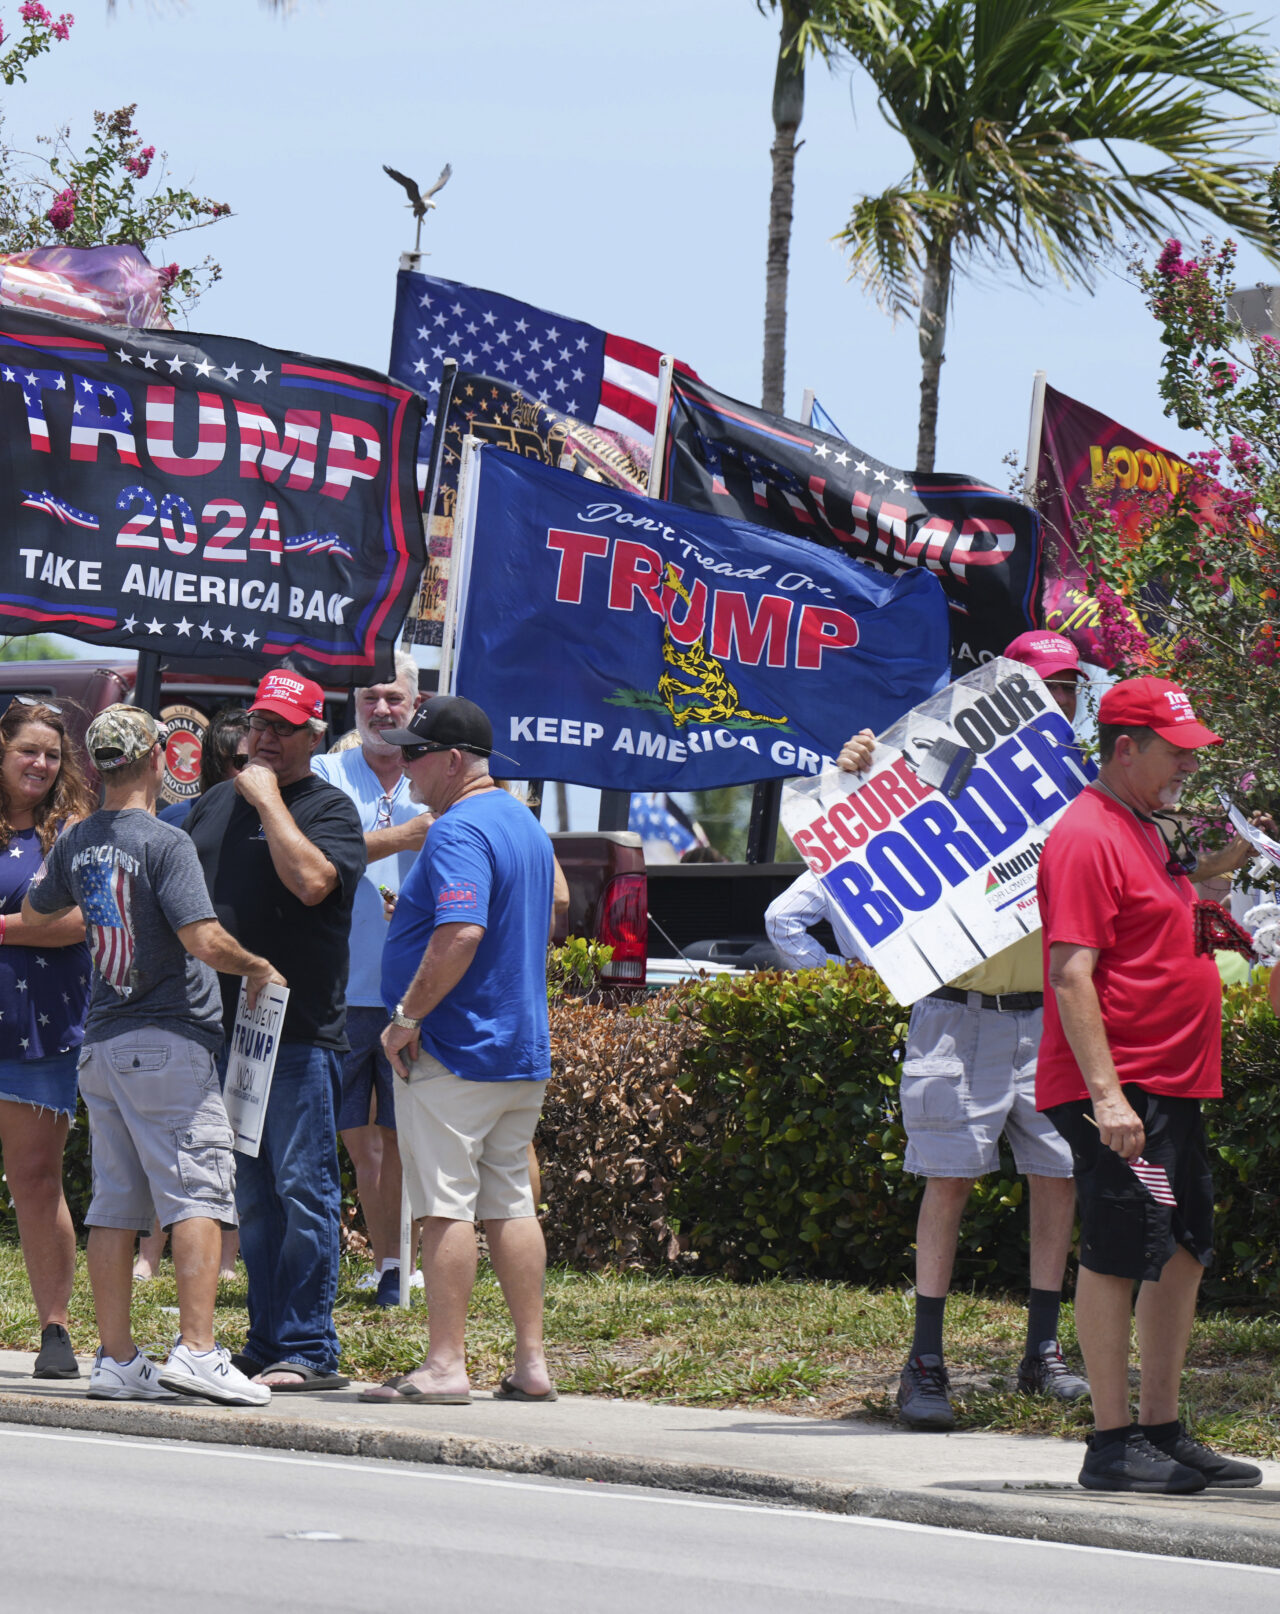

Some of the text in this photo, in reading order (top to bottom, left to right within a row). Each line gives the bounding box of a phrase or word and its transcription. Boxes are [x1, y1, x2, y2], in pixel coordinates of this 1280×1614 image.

[0, 361, 383, 501] TRUMP
[115, 485, 284, 566] 2024
[577, 502, 677, 543] Don't
[679, 537, 767, 580] Tread
[695, 428, 1017, 586] TRUMP
[19, 548, 103, 592] TAKE
[121, 563, 282, 613] AMERICA
[546, 527, 859, 671] TRUMP
[174, 706, 196, 715] LIFE
[267, 675, 305, 692] Trump
[509, 716, 605, 747] KEEP
[613, 728, 761, 765] AMERICA
[792, 672, 1047, 874] SECURE OUR
[819, 711, 1099, 948] BORDER
[439, 889, 473, 903] MAGA
[233, 1023, 274, 1063] TRUMP
